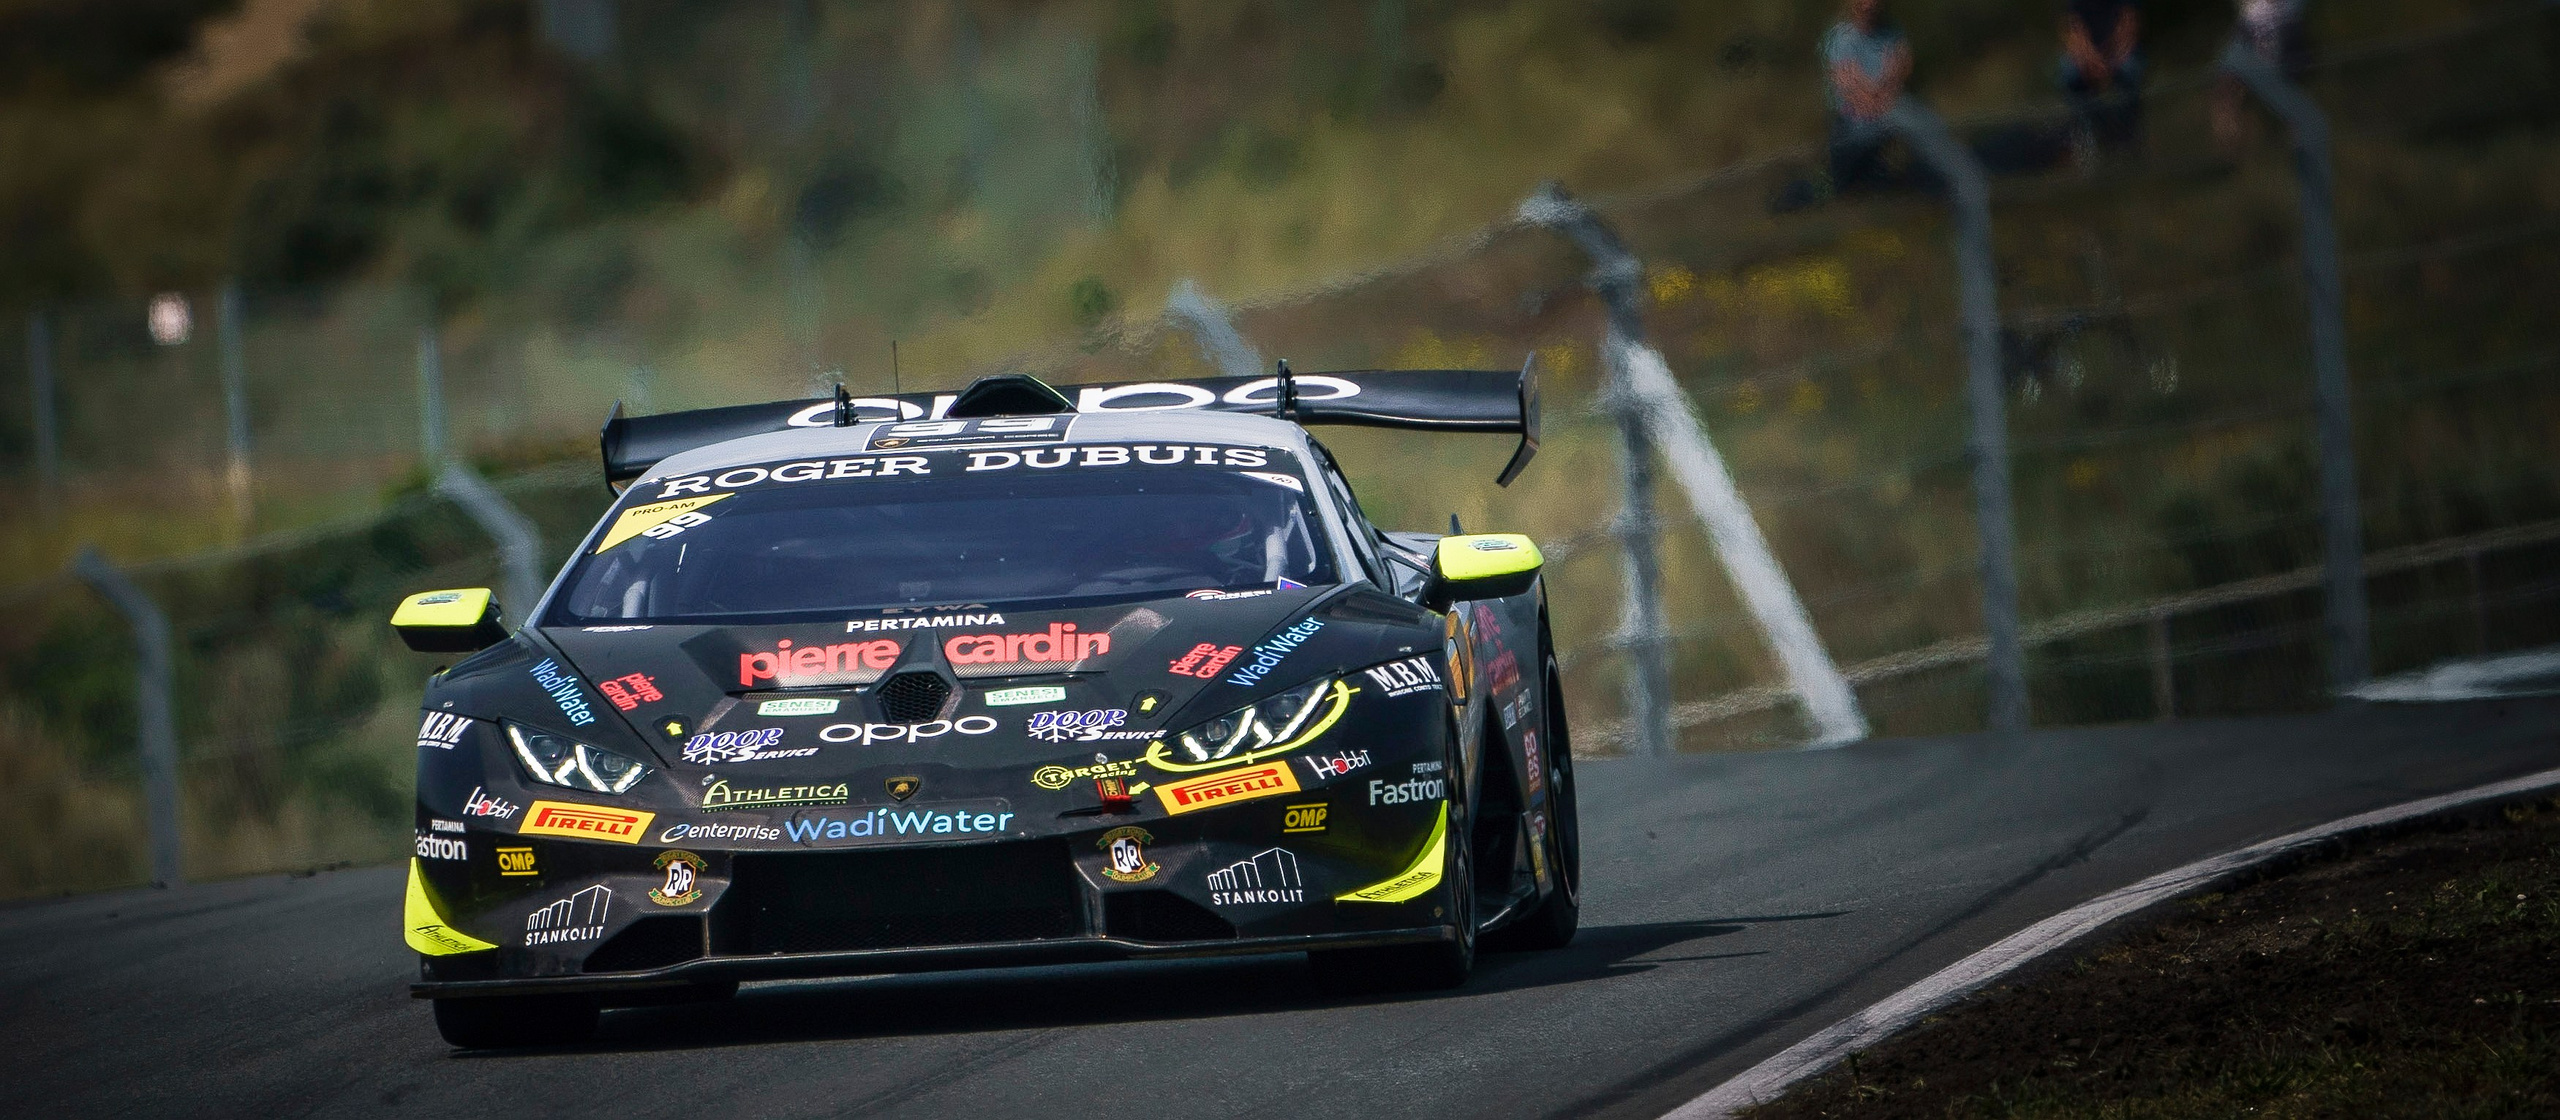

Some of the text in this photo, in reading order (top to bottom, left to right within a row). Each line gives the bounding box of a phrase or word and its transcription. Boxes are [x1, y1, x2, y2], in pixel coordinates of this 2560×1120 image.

[657, 446, 1269, 499] ROGER DUBUIS
[632, 500, 696, 517] PRO-AM
[642, 511, 713, 539] 99
[846, 614, 1005, 633] PERTAMINA
[740, 623, 1111, 687] pierre cardin
[1169, 644, 1217, 677] pierre
[1195, 645, 1242, 679] cardin
[1226, 616, 1326, 689] WadiWater
[529, 657, 594, 727] WadiWater
[598, 679, 640, 711] cardin
[617, 671, 665, 704] pierre
[992, 689, 1058, 698] SENESI
[766, 701, 832, 709] SENESI
[820, 716, 997, 745] oppo
[1032, 709, 1128, 731] DOOR
[685, 728, 784, 752] DOOR
[1080, 726, 1168, 744] SERVICE
[728, 746, 820, 764] SERVICE
[1040, 760, 1134, 785] TARGET
[1093, 769, 1137, 780] racing
[703, 780, 850, 805] ATHLETICA
[1172, 769, 1282, 805] PIRELLI
[1369, 778, 1445, 806] Fastron
[535, 807, 639, 835] PIRELLI
[785, 810, 1015, 843] WadiWater
[1285, 808, 1327, 827] OMP
[687, 825, 780, 842] enterprise
[499, 852, 534, 870] OMP
[1213, 888, 1304, 906] STANKOLIT
[525, 926, 605, 946] STANKOLIT
